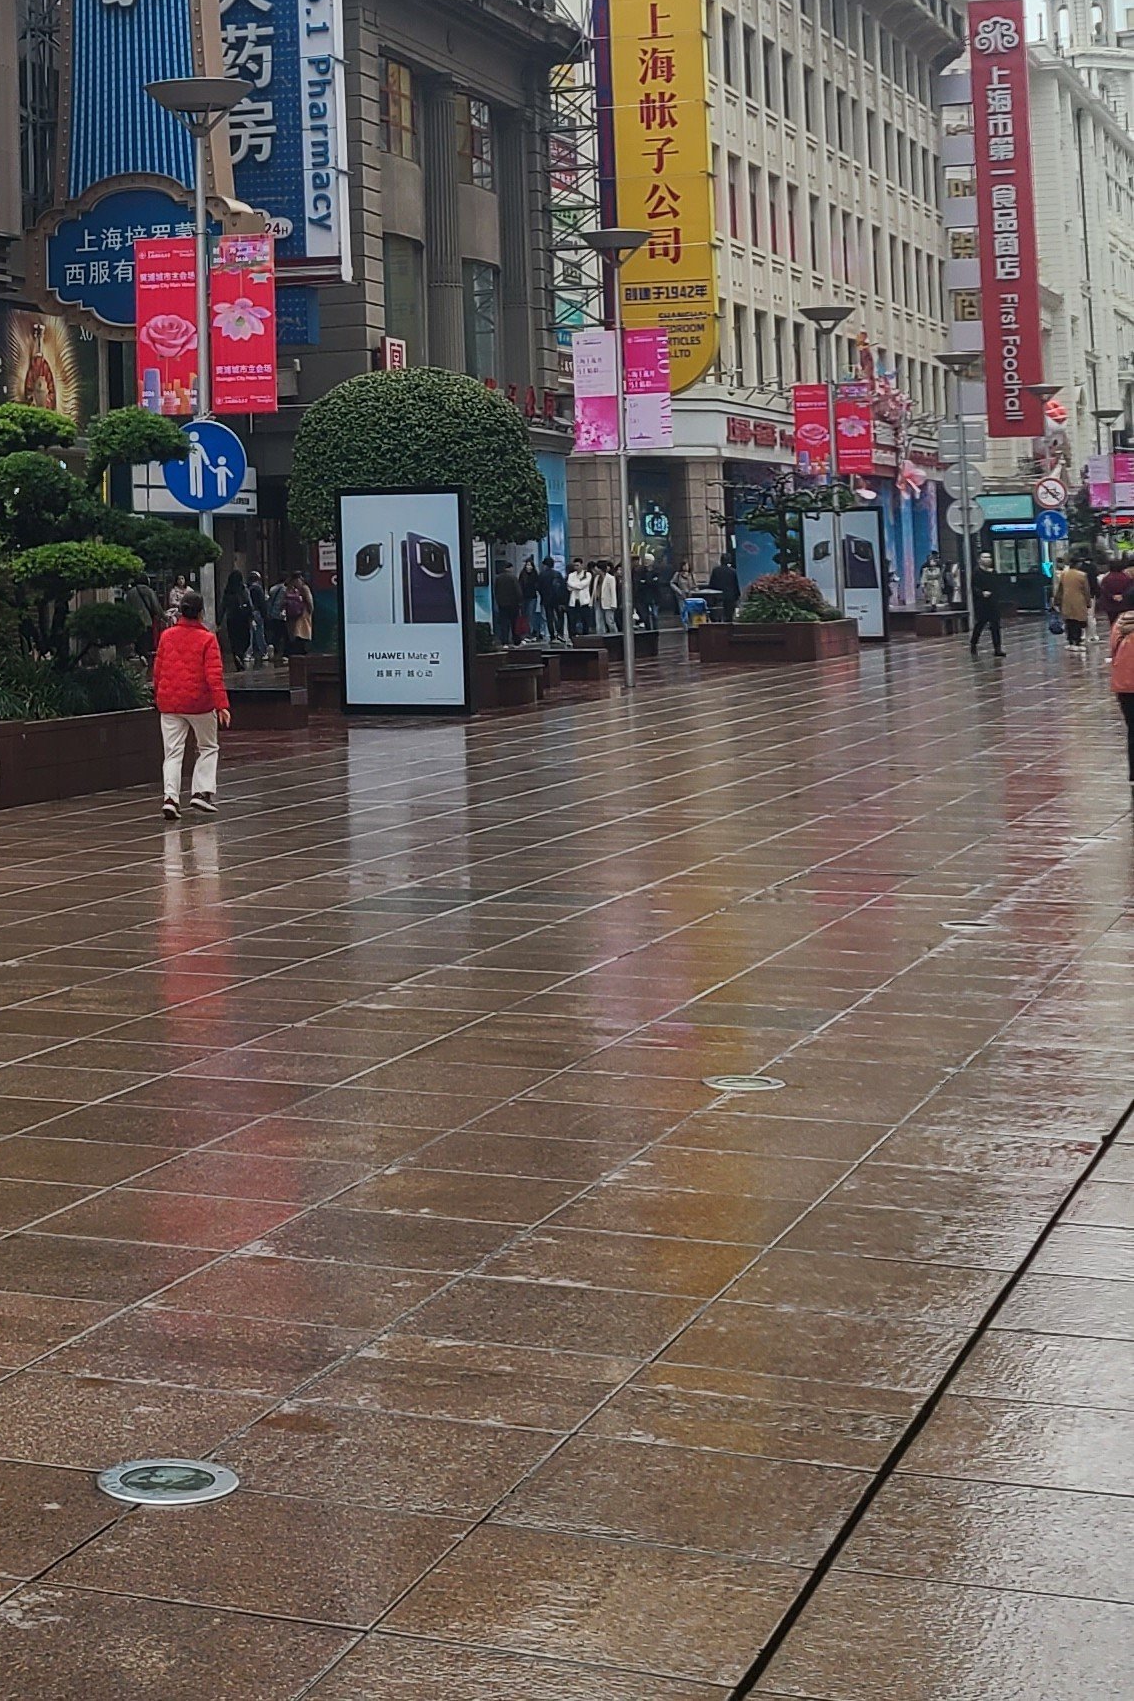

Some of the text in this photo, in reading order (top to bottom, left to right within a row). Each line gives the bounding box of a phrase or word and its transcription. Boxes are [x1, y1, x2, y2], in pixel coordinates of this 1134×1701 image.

[306, 55, 333, 233] Pharmacy
[637, 2, 683, 265] 上海帐子公司
[985, 65, 1022, 281] 上海市第一食品商店
[668, 336, 701, 346] RTICLES
[998, 294, 1024, 421] First Foodhall
[367, 652, 440, 660] HUAWEI Mate X7
